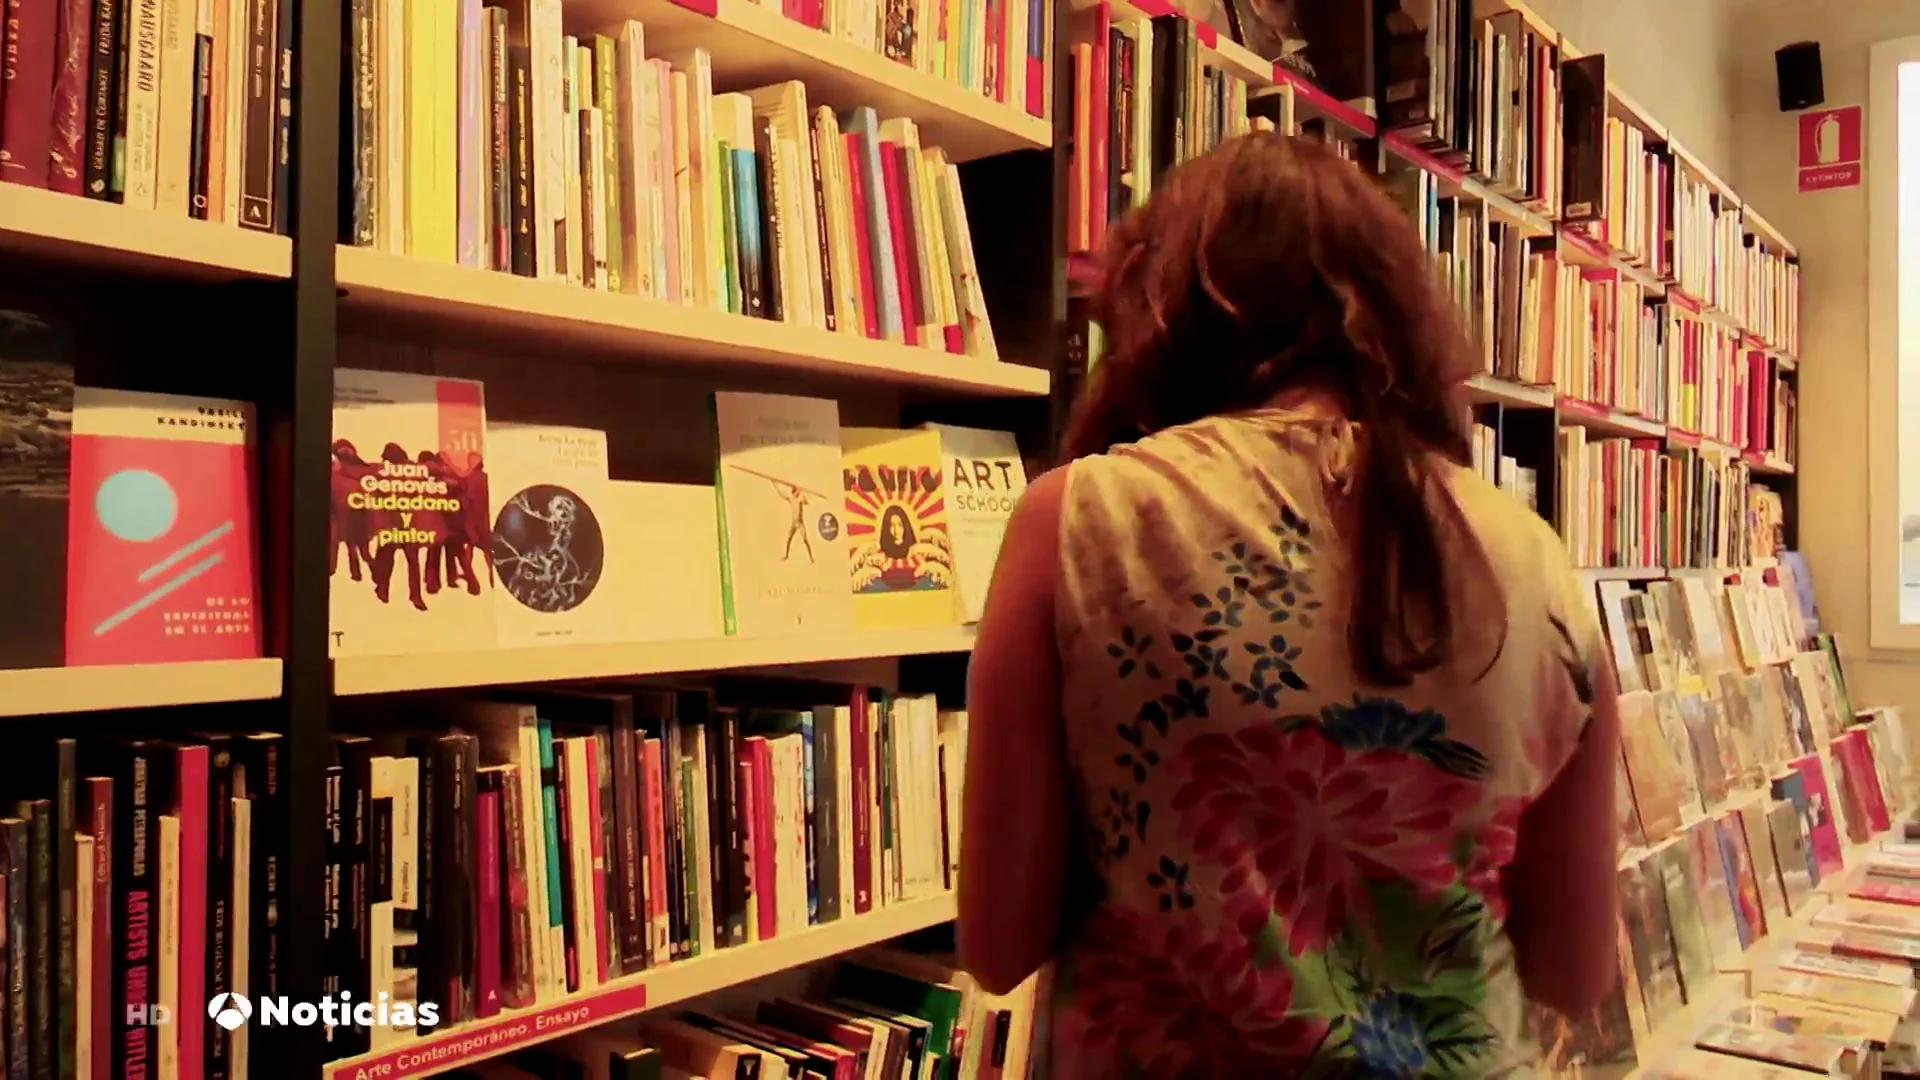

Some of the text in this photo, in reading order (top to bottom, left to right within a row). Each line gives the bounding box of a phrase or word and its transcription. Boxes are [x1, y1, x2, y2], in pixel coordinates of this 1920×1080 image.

[379, 461, 429, 477] Juan
[953, 458, 1011, 490] ART
[360, 475, 448, 495] Genovés
[347, 492, 460, 511] Ciudadano
[400, 511, 413, 528] y
[378, 528, 437, 547] pintor
[126, 890, 149, 961] ARTISTS
[355, 1063, 392, 1080] Arte
[535, 1005, 590, 1031] Ensayo
